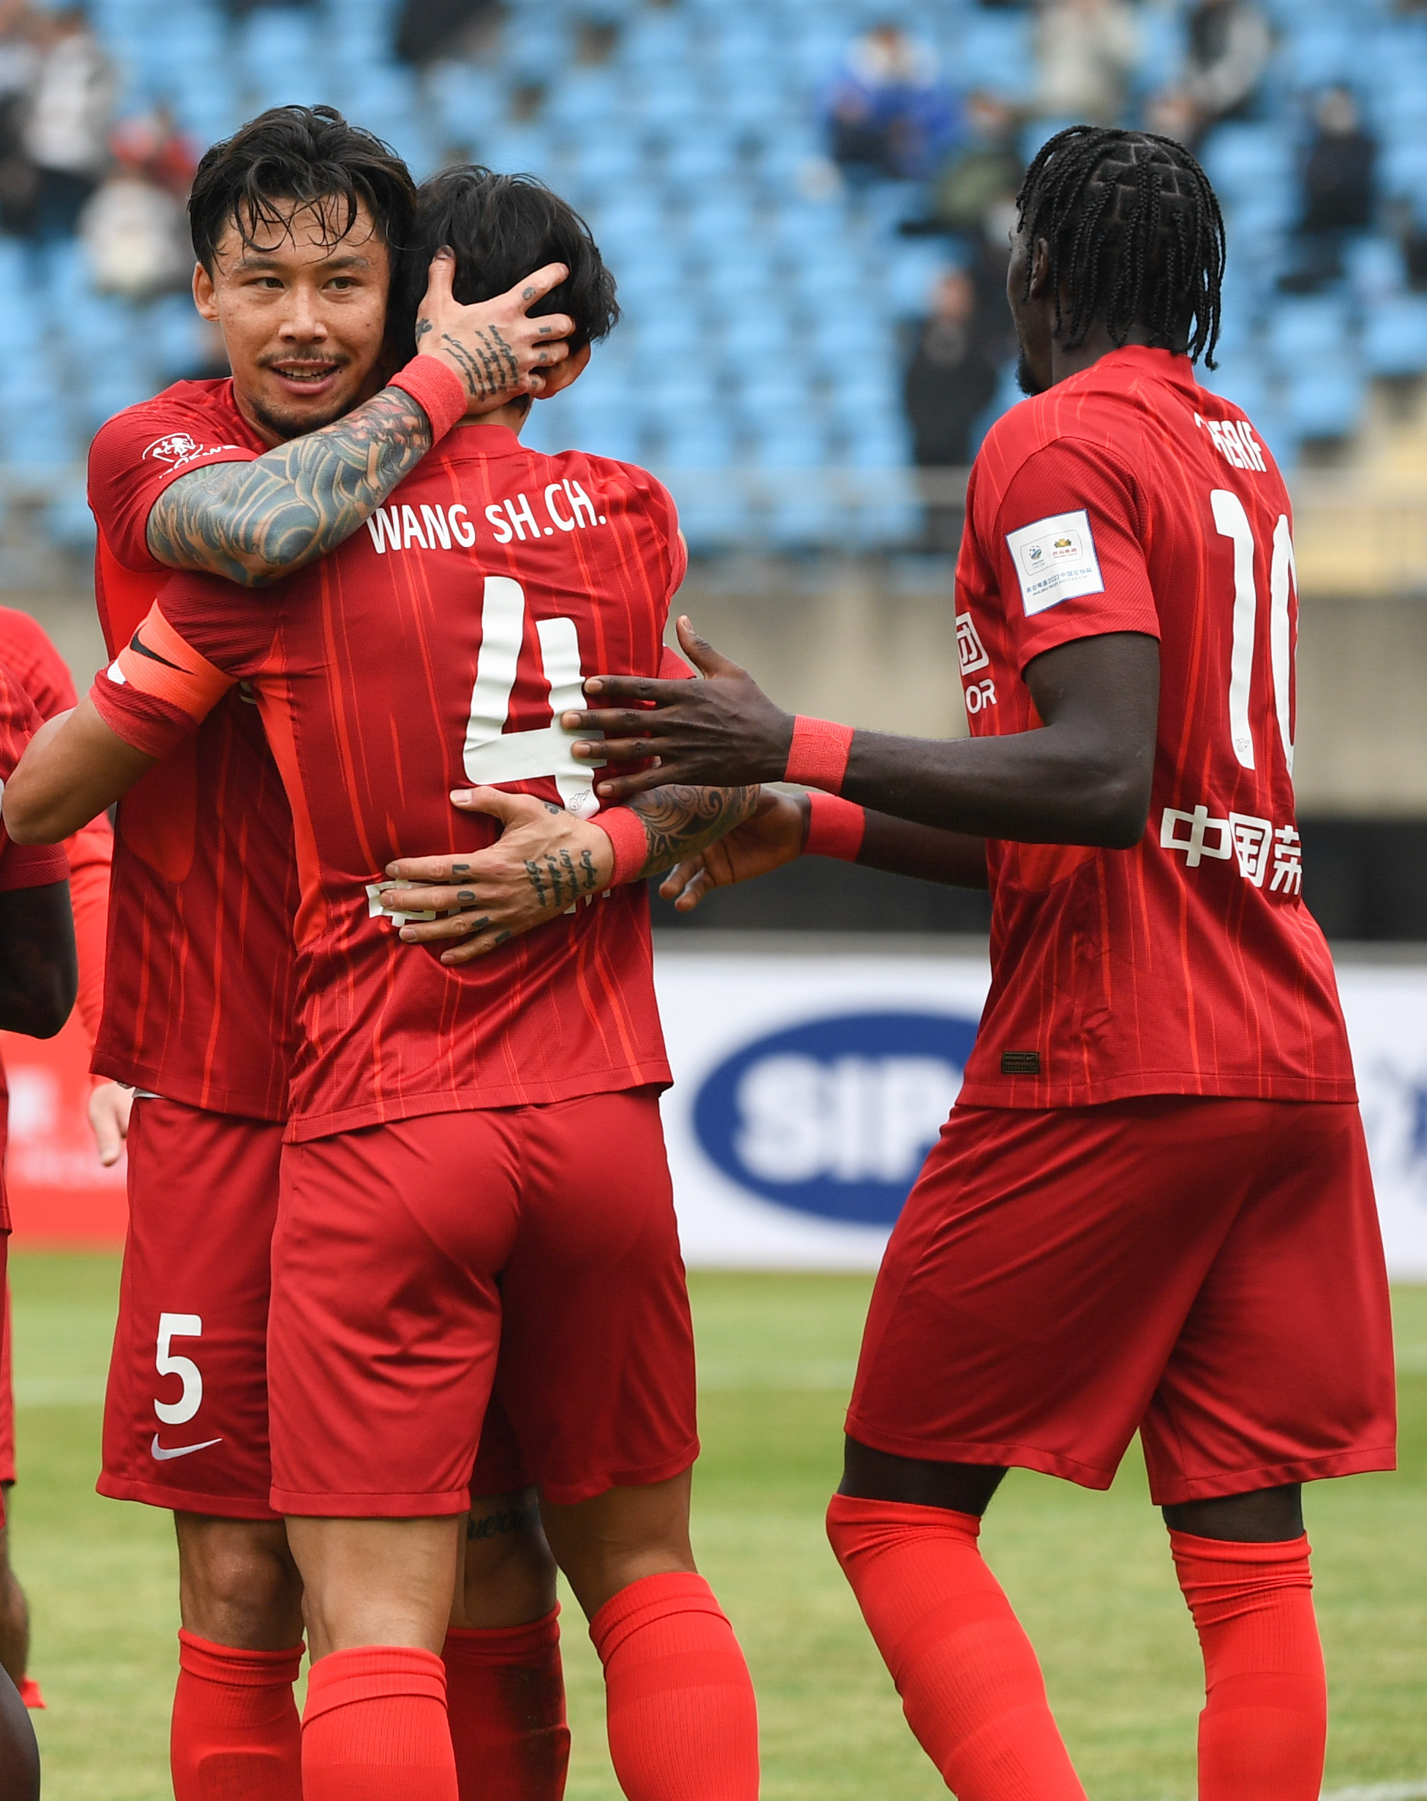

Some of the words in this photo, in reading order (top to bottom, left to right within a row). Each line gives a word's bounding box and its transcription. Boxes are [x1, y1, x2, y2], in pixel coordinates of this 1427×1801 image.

[367, 504, 475, 554] WANG
[485, 479, 607, 544] SH.CH.
[463, 576, 607, 820] 4
[1210, 489, 1298, 779] 10
[153, 1313, 203, 1425] 5
